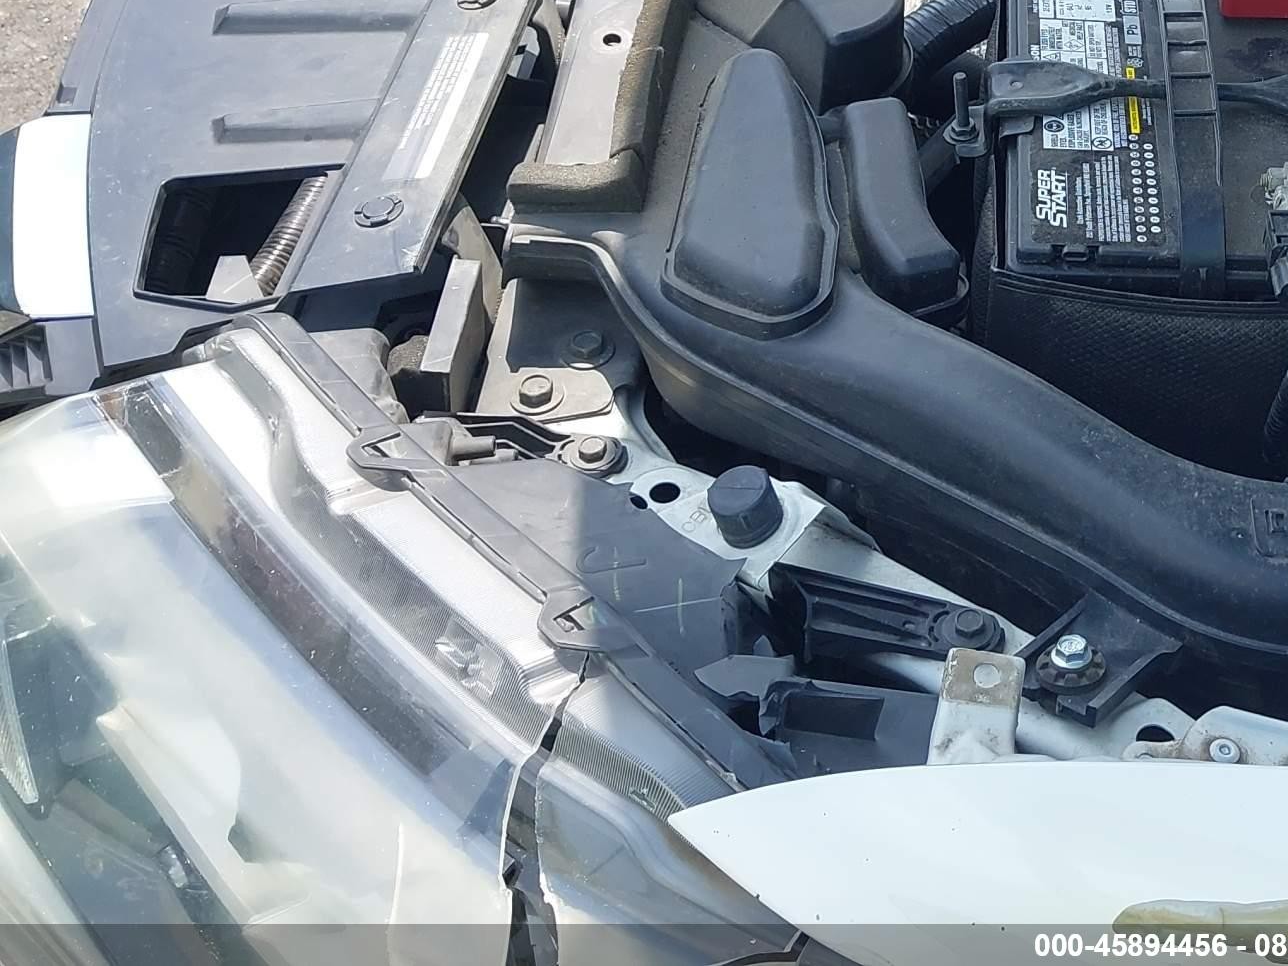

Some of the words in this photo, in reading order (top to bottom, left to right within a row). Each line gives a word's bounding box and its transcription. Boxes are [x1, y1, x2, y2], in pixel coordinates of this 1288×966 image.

[1127, 24, 1138, 35] Pb
[1036, 170, 1050, 220] SUPER
[1049, 169, 1067, 228] START
